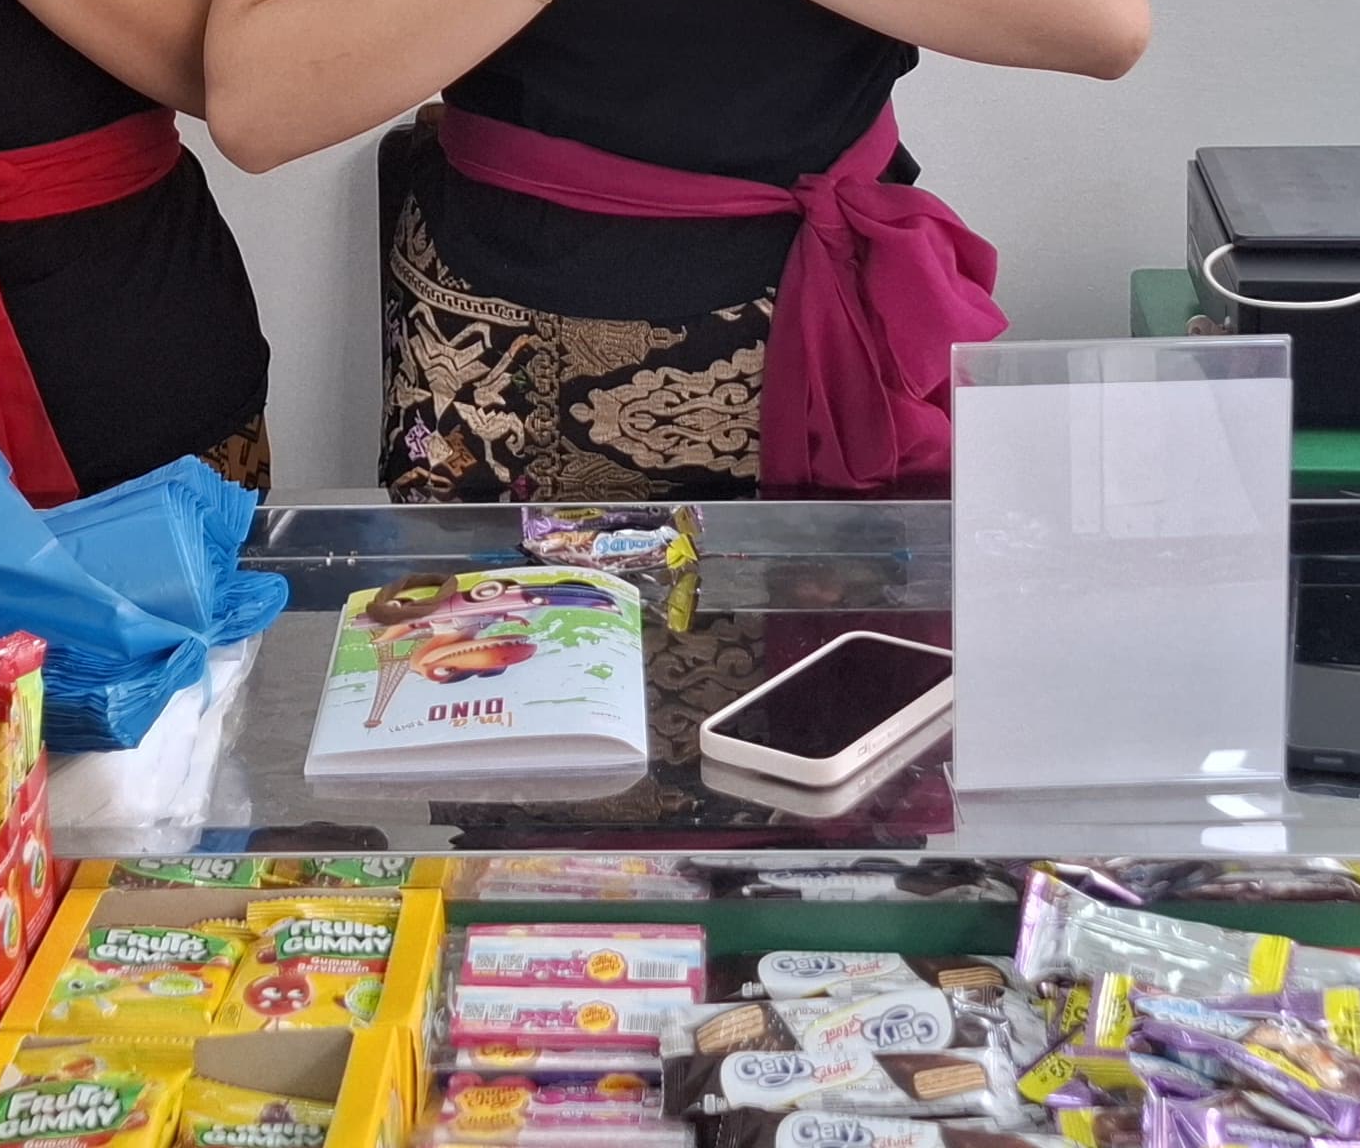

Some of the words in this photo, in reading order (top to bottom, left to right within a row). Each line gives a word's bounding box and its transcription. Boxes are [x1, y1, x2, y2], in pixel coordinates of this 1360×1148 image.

[428, 697, 504, 722] DINO
[283, 935, 391, 953] GUMMY
[310, 957, 360, 967] Gummy
[772, 955, 844, 977] Gery
[862, 1005, 939, 1047] Gery
[736, 1052, 814, 1088] Gery
[792, 1116, 874, 1148] Gery
